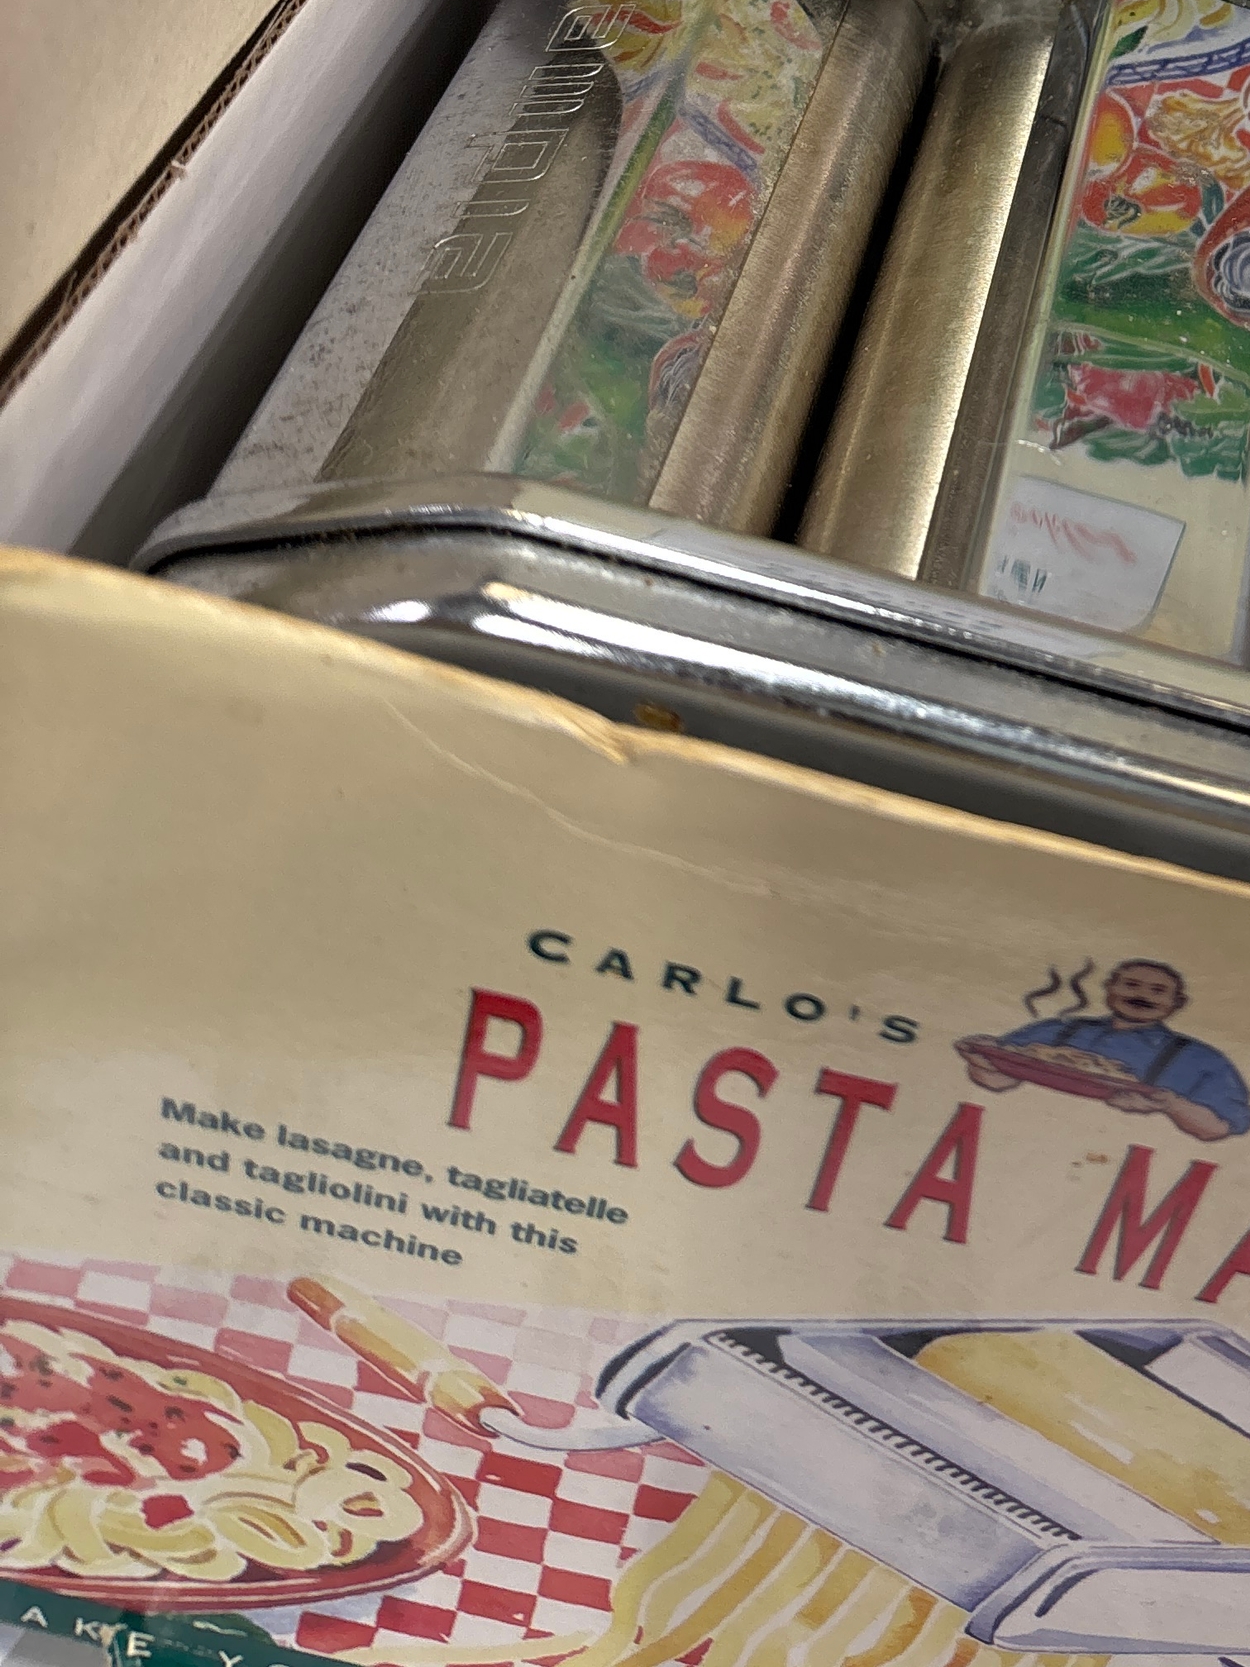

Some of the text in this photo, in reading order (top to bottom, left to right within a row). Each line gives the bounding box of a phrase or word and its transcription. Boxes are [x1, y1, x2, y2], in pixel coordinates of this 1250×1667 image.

[527, 928, 922, 1046] CARLO'S
[160, 1096, 629, 1235] Make lasagne, tagliatelle
[446, 986, 987, 1245] PASTA
[155, 1180, 464, 1266] classic machine
[157, 1141, 579, 1255] and tagliolini with this
